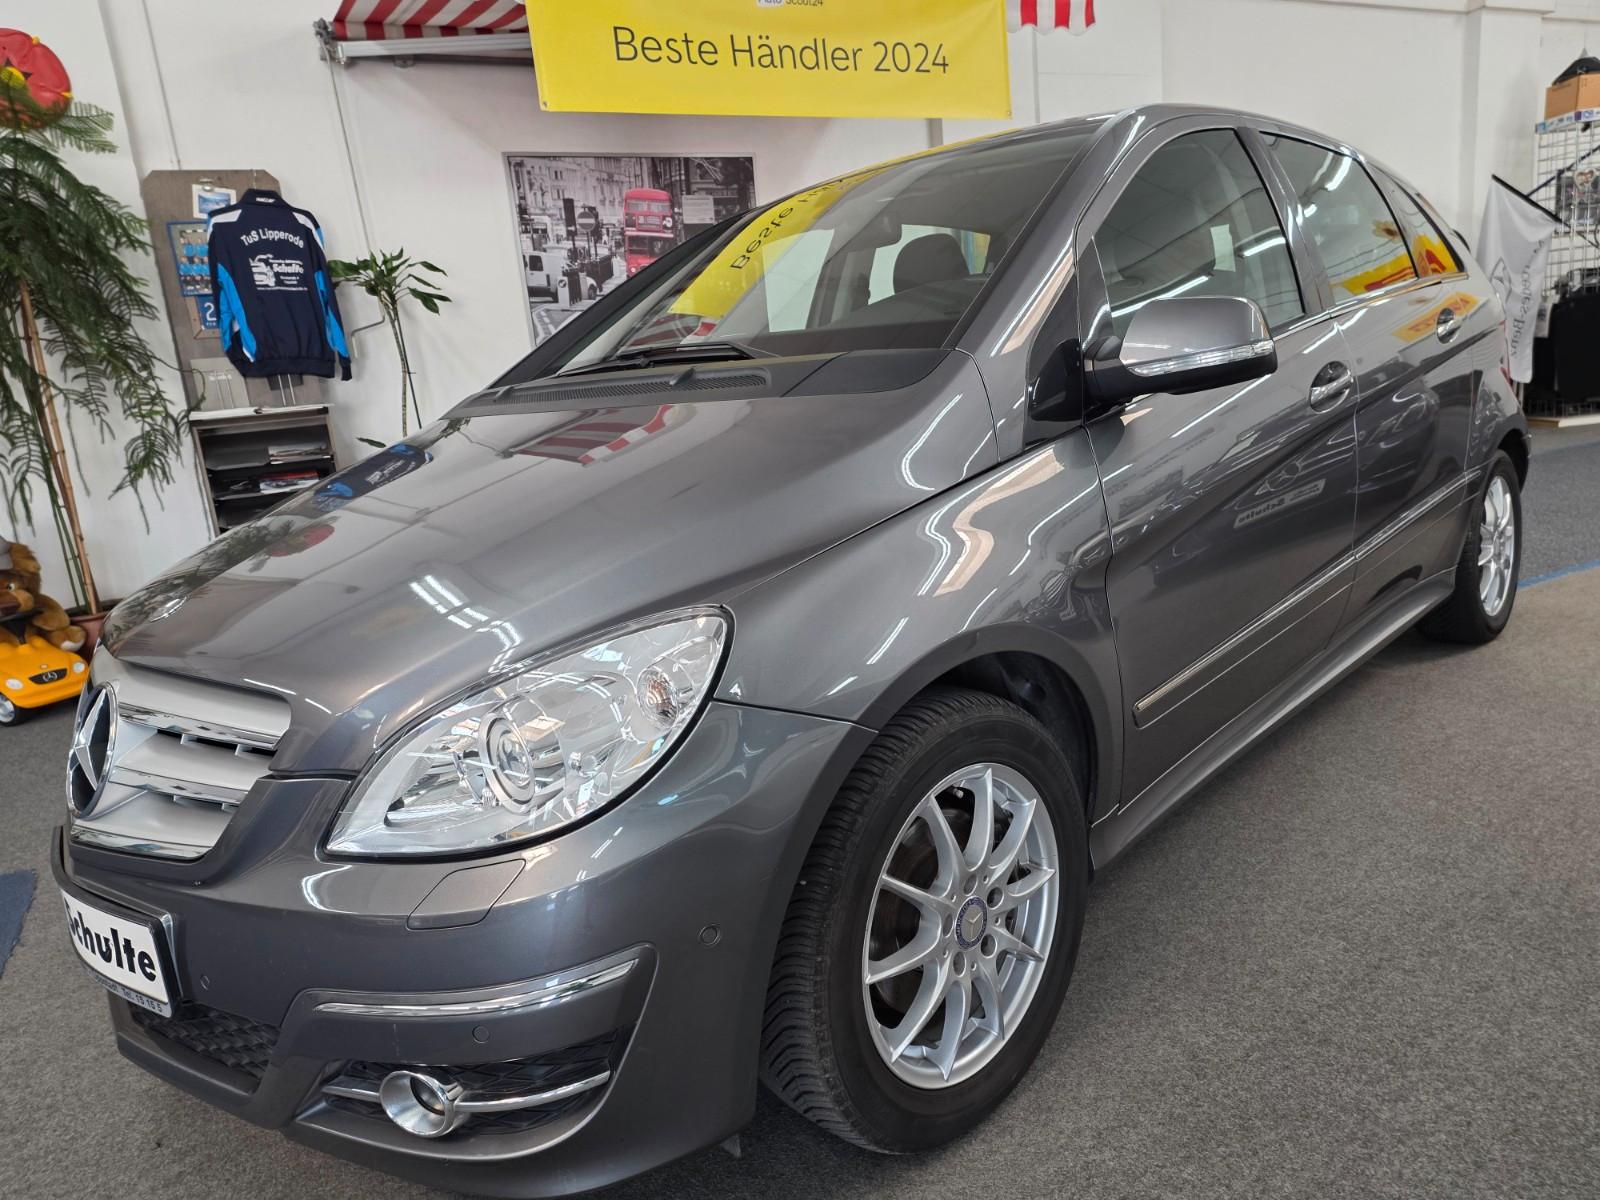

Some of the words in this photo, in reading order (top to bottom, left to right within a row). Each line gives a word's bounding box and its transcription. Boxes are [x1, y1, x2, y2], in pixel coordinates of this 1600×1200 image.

[613, 26, 718, 66] Beste
[729, 34, 863, 71] Händler
[873, 41, 949, 74] 2024
[240, 230, 260, 246] TuS
[258, 228, 304, 248] Lipperode
